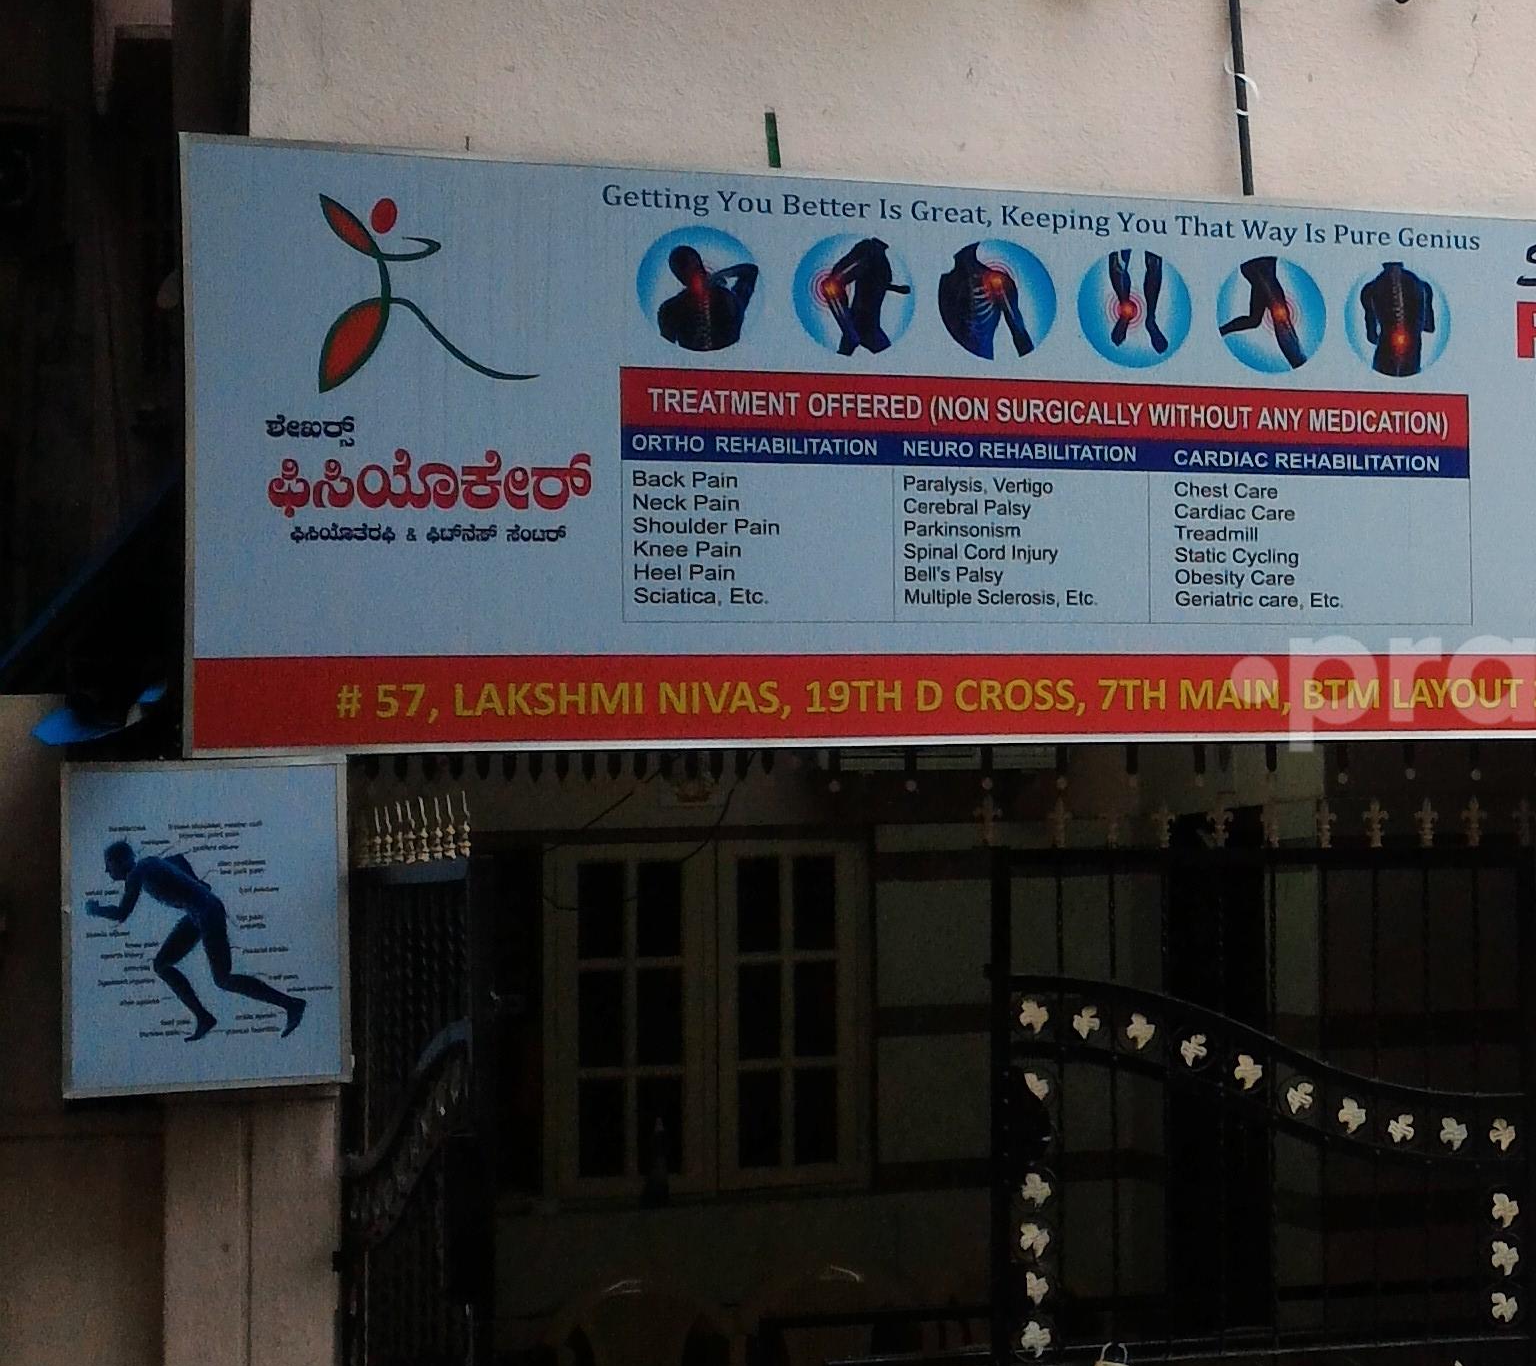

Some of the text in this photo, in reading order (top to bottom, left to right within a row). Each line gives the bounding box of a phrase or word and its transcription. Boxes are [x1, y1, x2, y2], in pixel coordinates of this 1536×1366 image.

[602, 184, 1480, 251] Getting You Better Is Great, Keeping You That Way Is Pure Genius
[647, 388, 1448, 440] TREATMENT OFFERED (NON SURGICALLY WITHOUT ANY MEDICATION)
[632, 434, 877, 456] ORTHO REHABILITATION
[903, 440, 1136, 462] NEURO REHABILITATION
[1174, 450, 1439, 472] CARDIAC REHABILITATION
[632, 470, 738, 488] Back Pain
[903, 475, 1053, 496] Paralysis, Vertigo
[1174, 481, 1278, 499] Chest Care
[633, 494, 740, 511] Neck Pain
[903, 498, 1031, 519] Cerebral Palsy
[1174, 503, 1295, 522] Cardiac Care
[407, 527, 417, 542] &
[633, 517, 780, 535] Shoulder Pain
[904, 521, 1021, 538] Parkinsonism
[1174, 526, 1258, 542] Treadmill
[633, 541, 741, 557] Knee Pain
[904, 543, 1058, 564] Spinal Cord Injury
[1174, 547, 1299, 568] Static Cycling
[634, 564, 735, 581] Heel Pain
[904, 566, 1003, 585] Bell's Palsy
[1175, 569, 1295, 588] Obesity Care
[633, 587, 769, 606] Sciatica, Etc.
[904, 589, 1098, 607] Multiple Sclerosis, Etc.
[1175, 591, 1344, 610] Geriatric care, Etc.
[336, 684, 362, 718] #
[375, 683, 439, 723] 57,
[453, 682, 645, 717] LAKSHMI
[658, 681, 791, 720] NIVAS,
[805, 680, 903, 713] 19TH
[915, 680, 944, 712] D
[955, 679, 1086, 718] CROSS,
[1098, 679, 1166, 712] 7TH
[1179, 678, 1291, 716] MAIN,
[1302, 678, 1380, 711] BTM
[1393, 678, 1525, 710] LAYOUT
